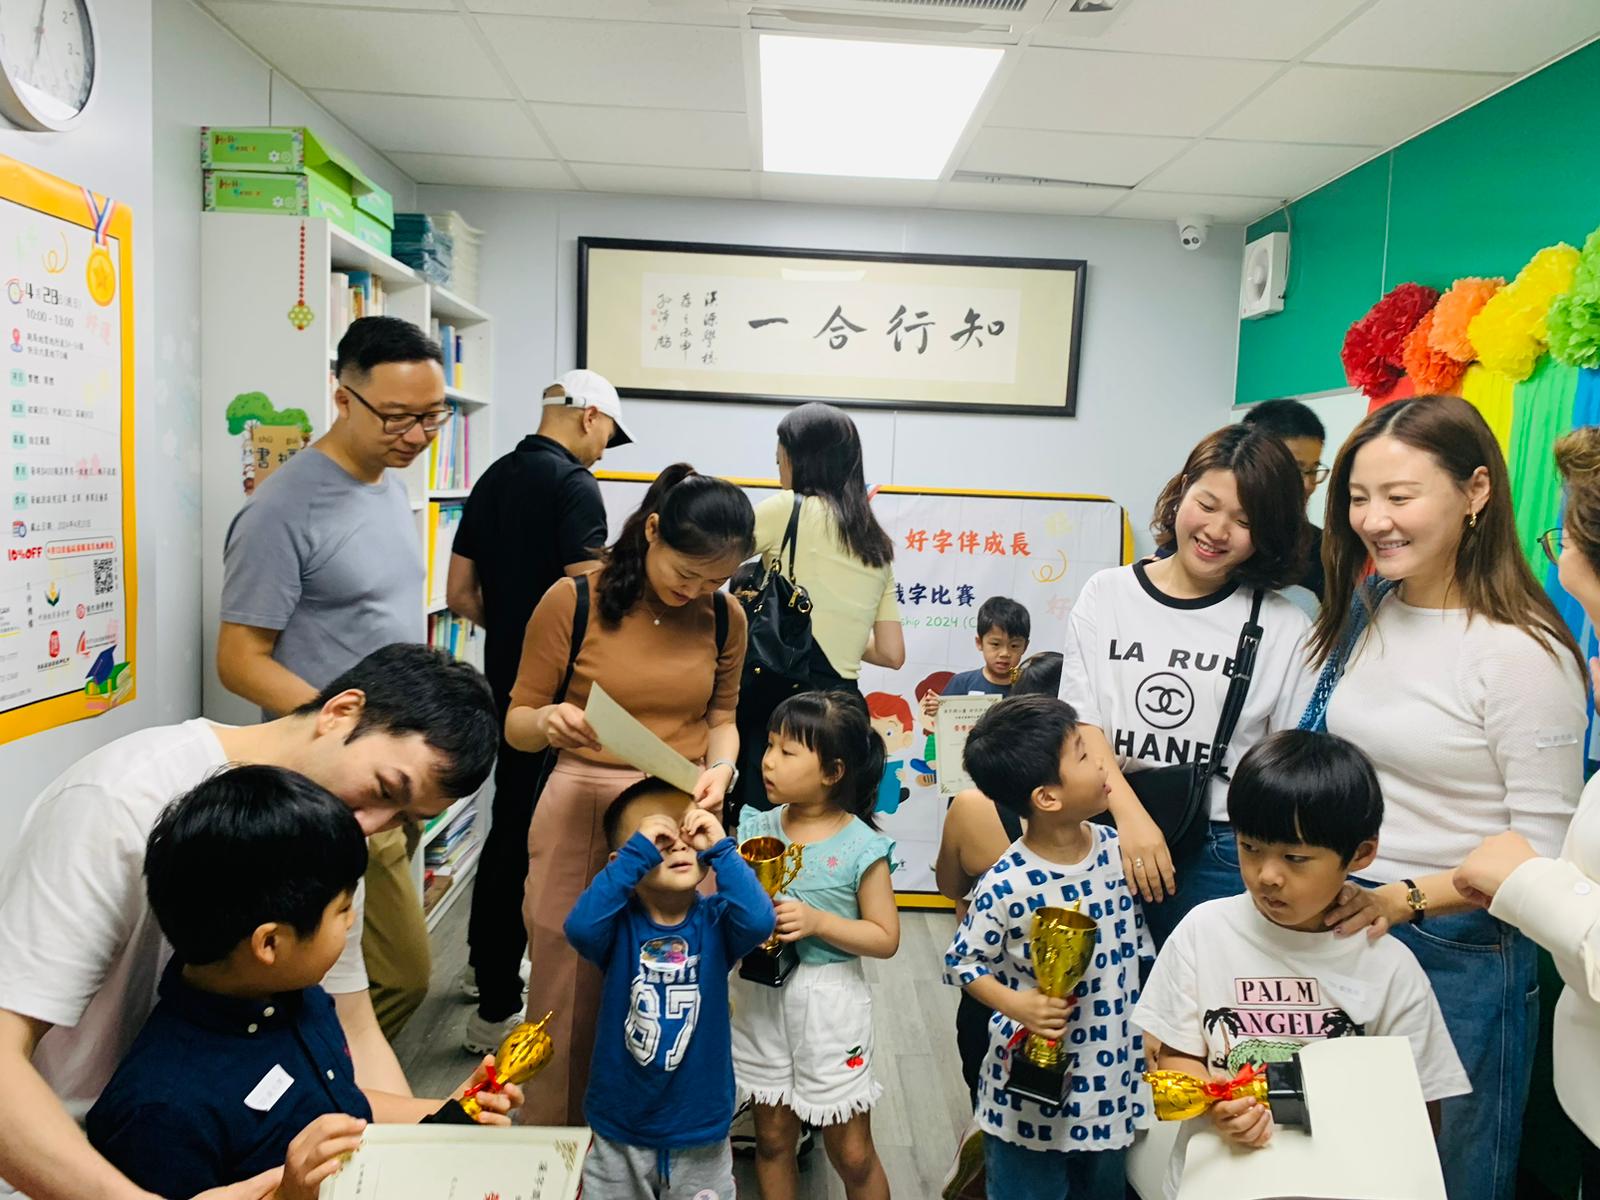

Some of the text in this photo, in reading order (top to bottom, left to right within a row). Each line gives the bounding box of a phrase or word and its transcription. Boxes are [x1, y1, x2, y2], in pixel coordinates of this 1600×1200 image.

[904, 528, 1032, 557] 好字伴成長
[900, 615, 978, 630] ship 2024 (C
[1109, 638, 1145, 663] LA
[1114, 728, 1211, 767] HANE
[1060, 879, 1093, 902] BE
[1008, 893, 1047, 919] ON
[1088, 898, 1115, 920] BE
[1241, 980, 1315, 1004] PALM
[1070, 1024, 1108, 1045] ON
[1071, 1075, 1106, 1093] BE
[1098, 1096, 1127, 1117] BE
[1017, 1119, 1111, 1142] BE ON
